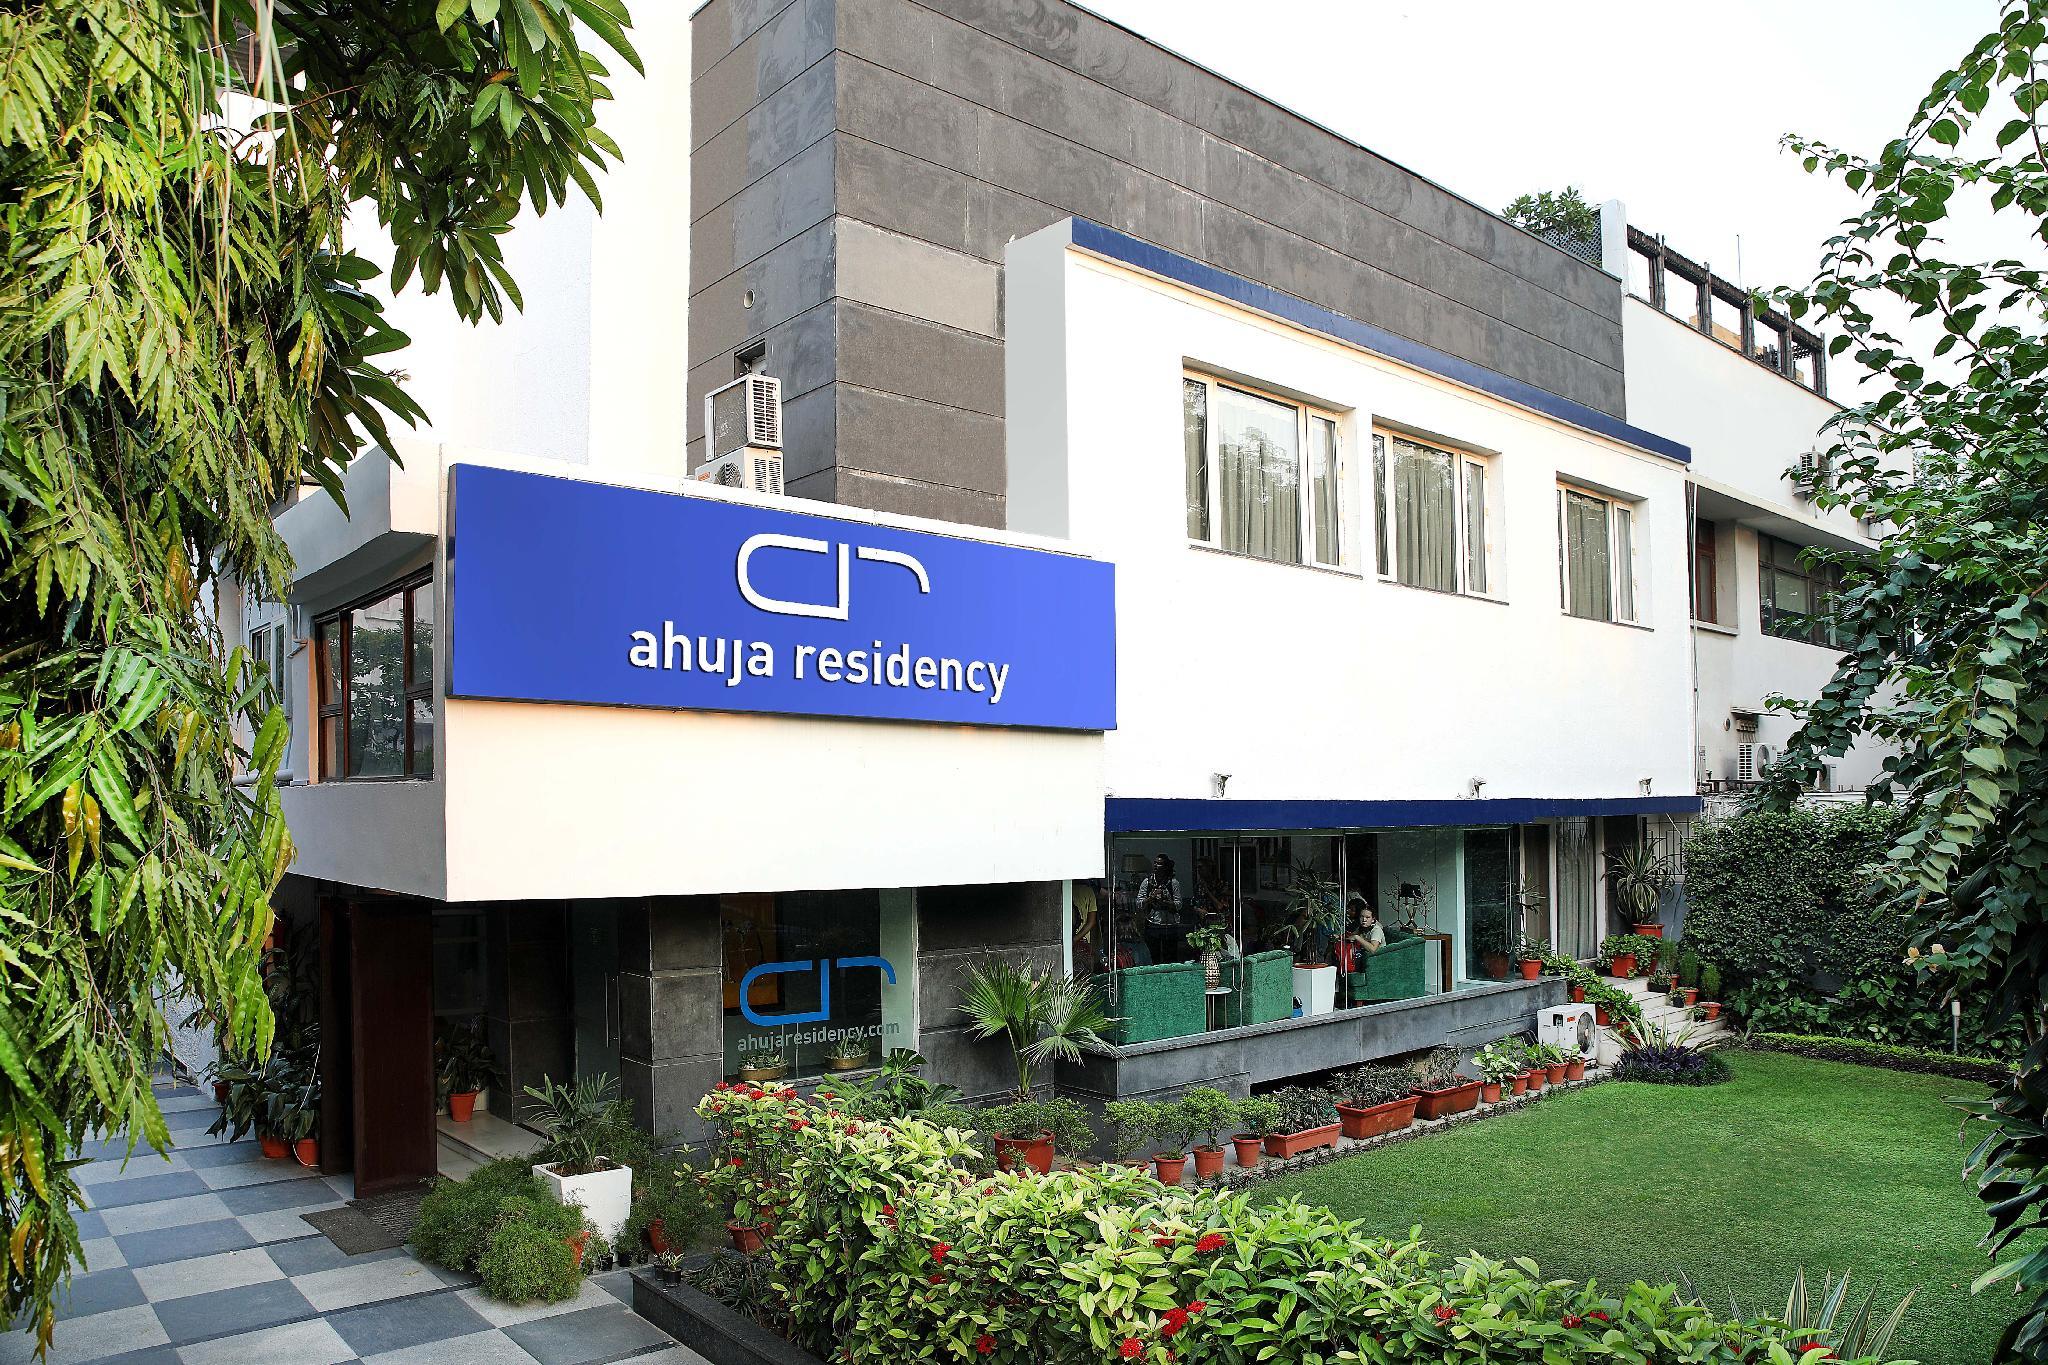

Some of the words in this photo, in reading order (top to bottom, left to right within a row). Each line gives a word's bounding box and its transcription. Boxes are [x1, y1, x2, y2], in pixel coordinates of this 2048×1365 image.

[629, 620, 775, 687] ahuja
[795, 639, 1011, 704] residency
[737, 1021, 900, 1051] ahujaresidency.com
